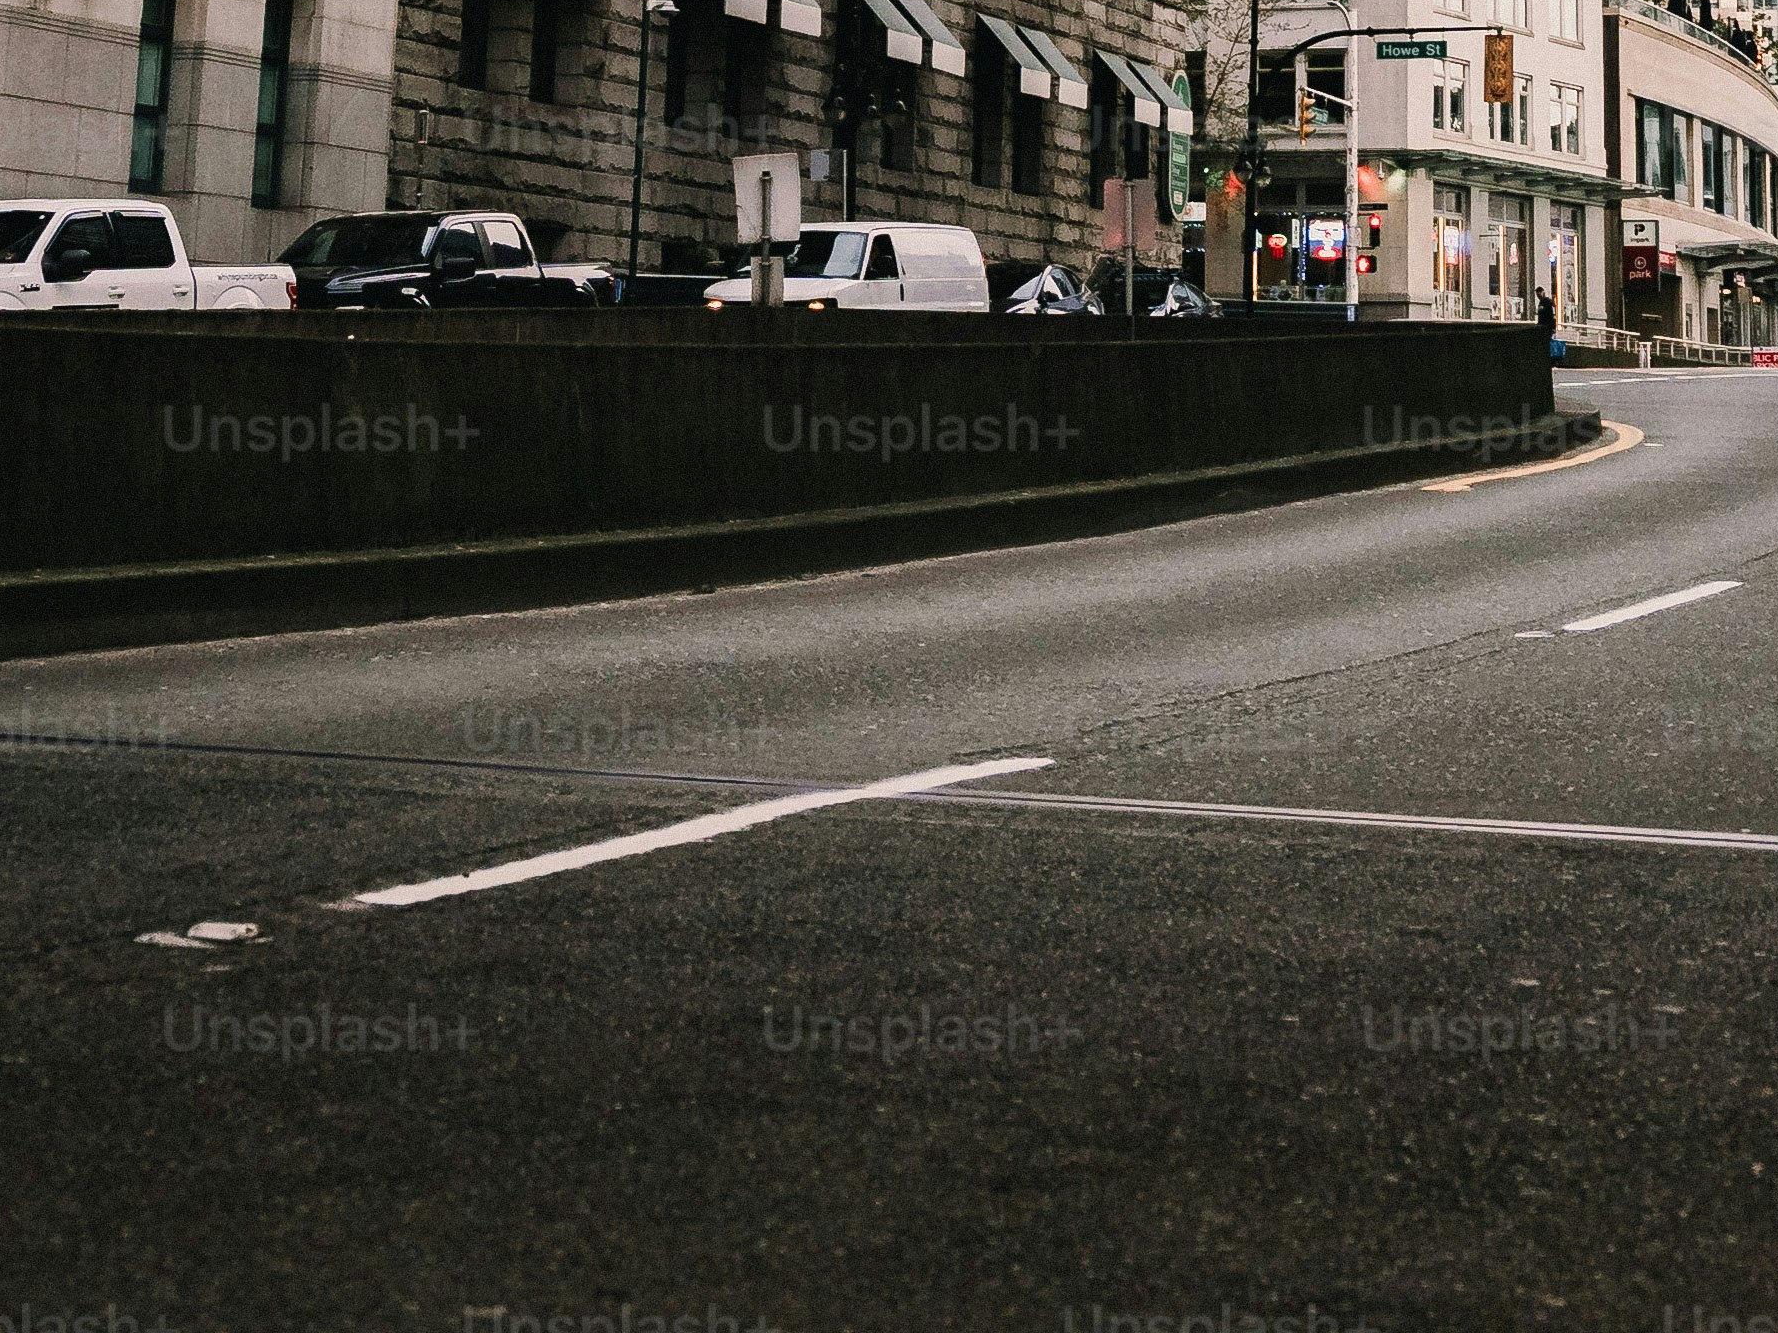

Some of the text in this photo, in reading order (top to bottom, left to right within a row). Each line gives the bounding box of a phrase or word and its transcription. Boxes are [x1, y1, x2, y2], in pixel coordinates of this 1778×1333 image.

[1382, 44, 1441, 56] Howe St
[1629, 269, 1652, 280] park
